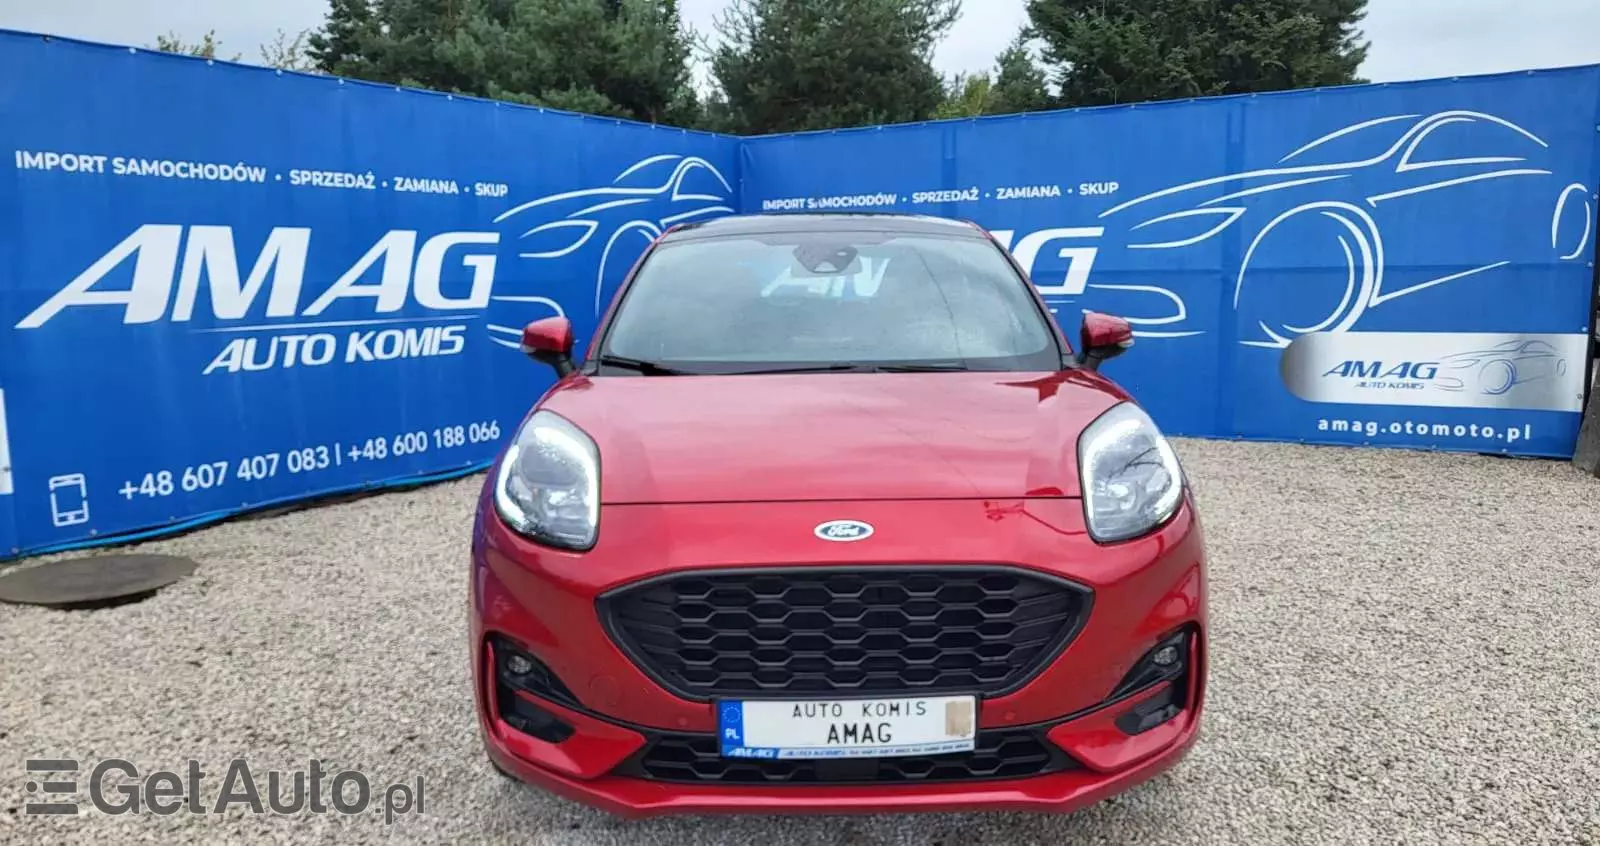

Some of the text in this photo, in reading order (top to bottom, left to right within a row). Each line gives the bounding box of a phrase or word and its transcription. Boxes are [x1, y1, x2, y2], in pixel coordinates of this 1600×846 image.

[15, 150, 508, 197] IMPORT SAMOCHODÓW SPRZEDAŻ ZAMIANA SKUP
[763, 199, 806, 210] IMPORT
[912, 187, 979, 204] SPRZEDAŻ
[996, 184, 1061, 200] ZAMIANA
[1079, 181, 1119, 196] SKUP
[202, 325, 466, 375] AUTO KOMIS
[1318, 416, 1532, 442] amag.otomoto.pl
[118, 471, 174, 499] +48
[181, 462, 227, 489] 607
[236, 453, 280, 480] 407
[287, 445, 330, 471] 083
[348, 437, 387, 462] +48
[393, 431, 428, 454] 600
[434, 425, 465, 448] 188
[469, 419, 500, 441] 066
[792, 701, 927, 718] AUTO KOMIS
[725, 728, 739, 740] PL
[826, 723, 892, 744] AMAG
